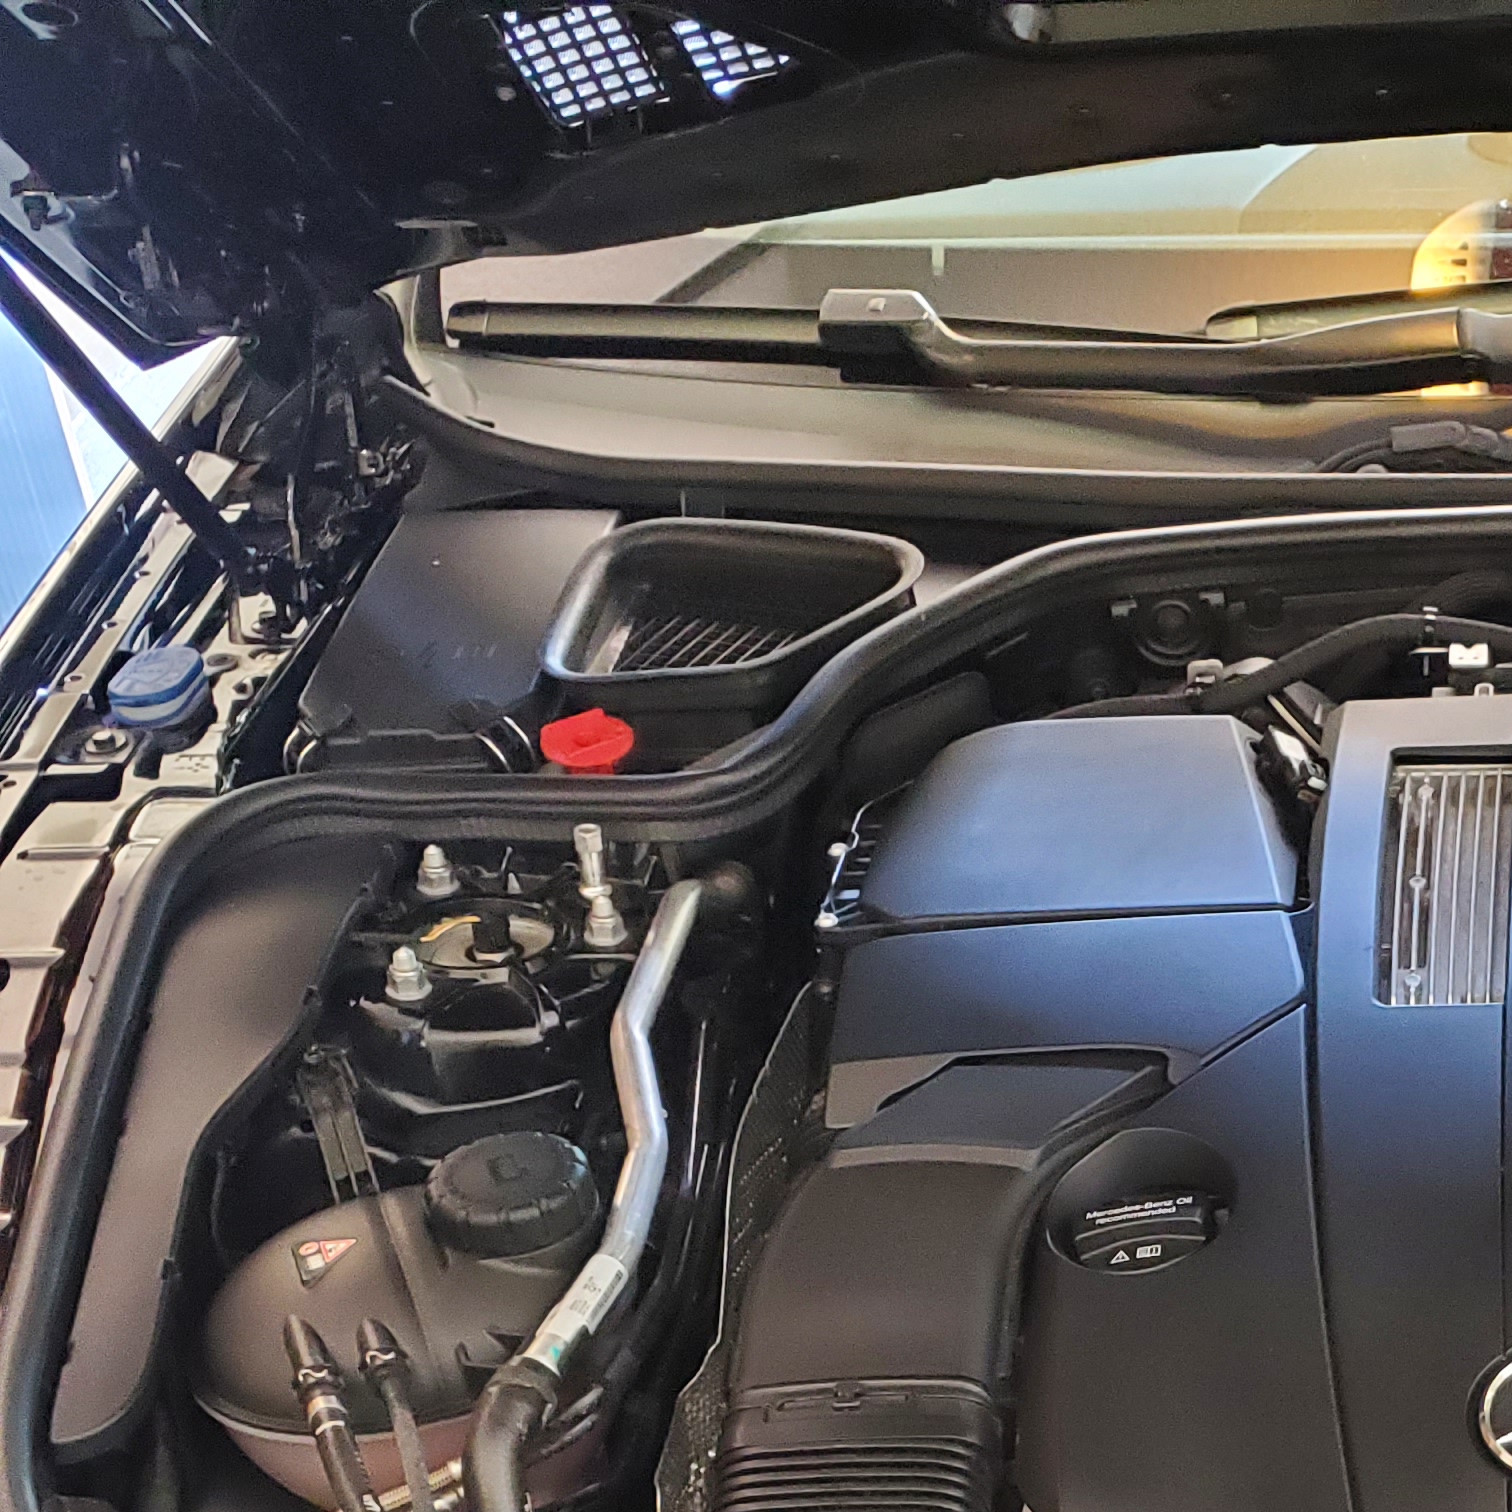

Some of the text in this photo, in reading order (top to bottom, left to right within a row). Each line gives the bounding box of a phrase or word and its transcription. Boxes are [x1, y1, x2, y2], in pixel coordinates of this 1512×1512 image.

[1086, 1196, 1193, 1220] Mercedes-Benz Oil
[1095, 1206, 1177, 1225] recommended
